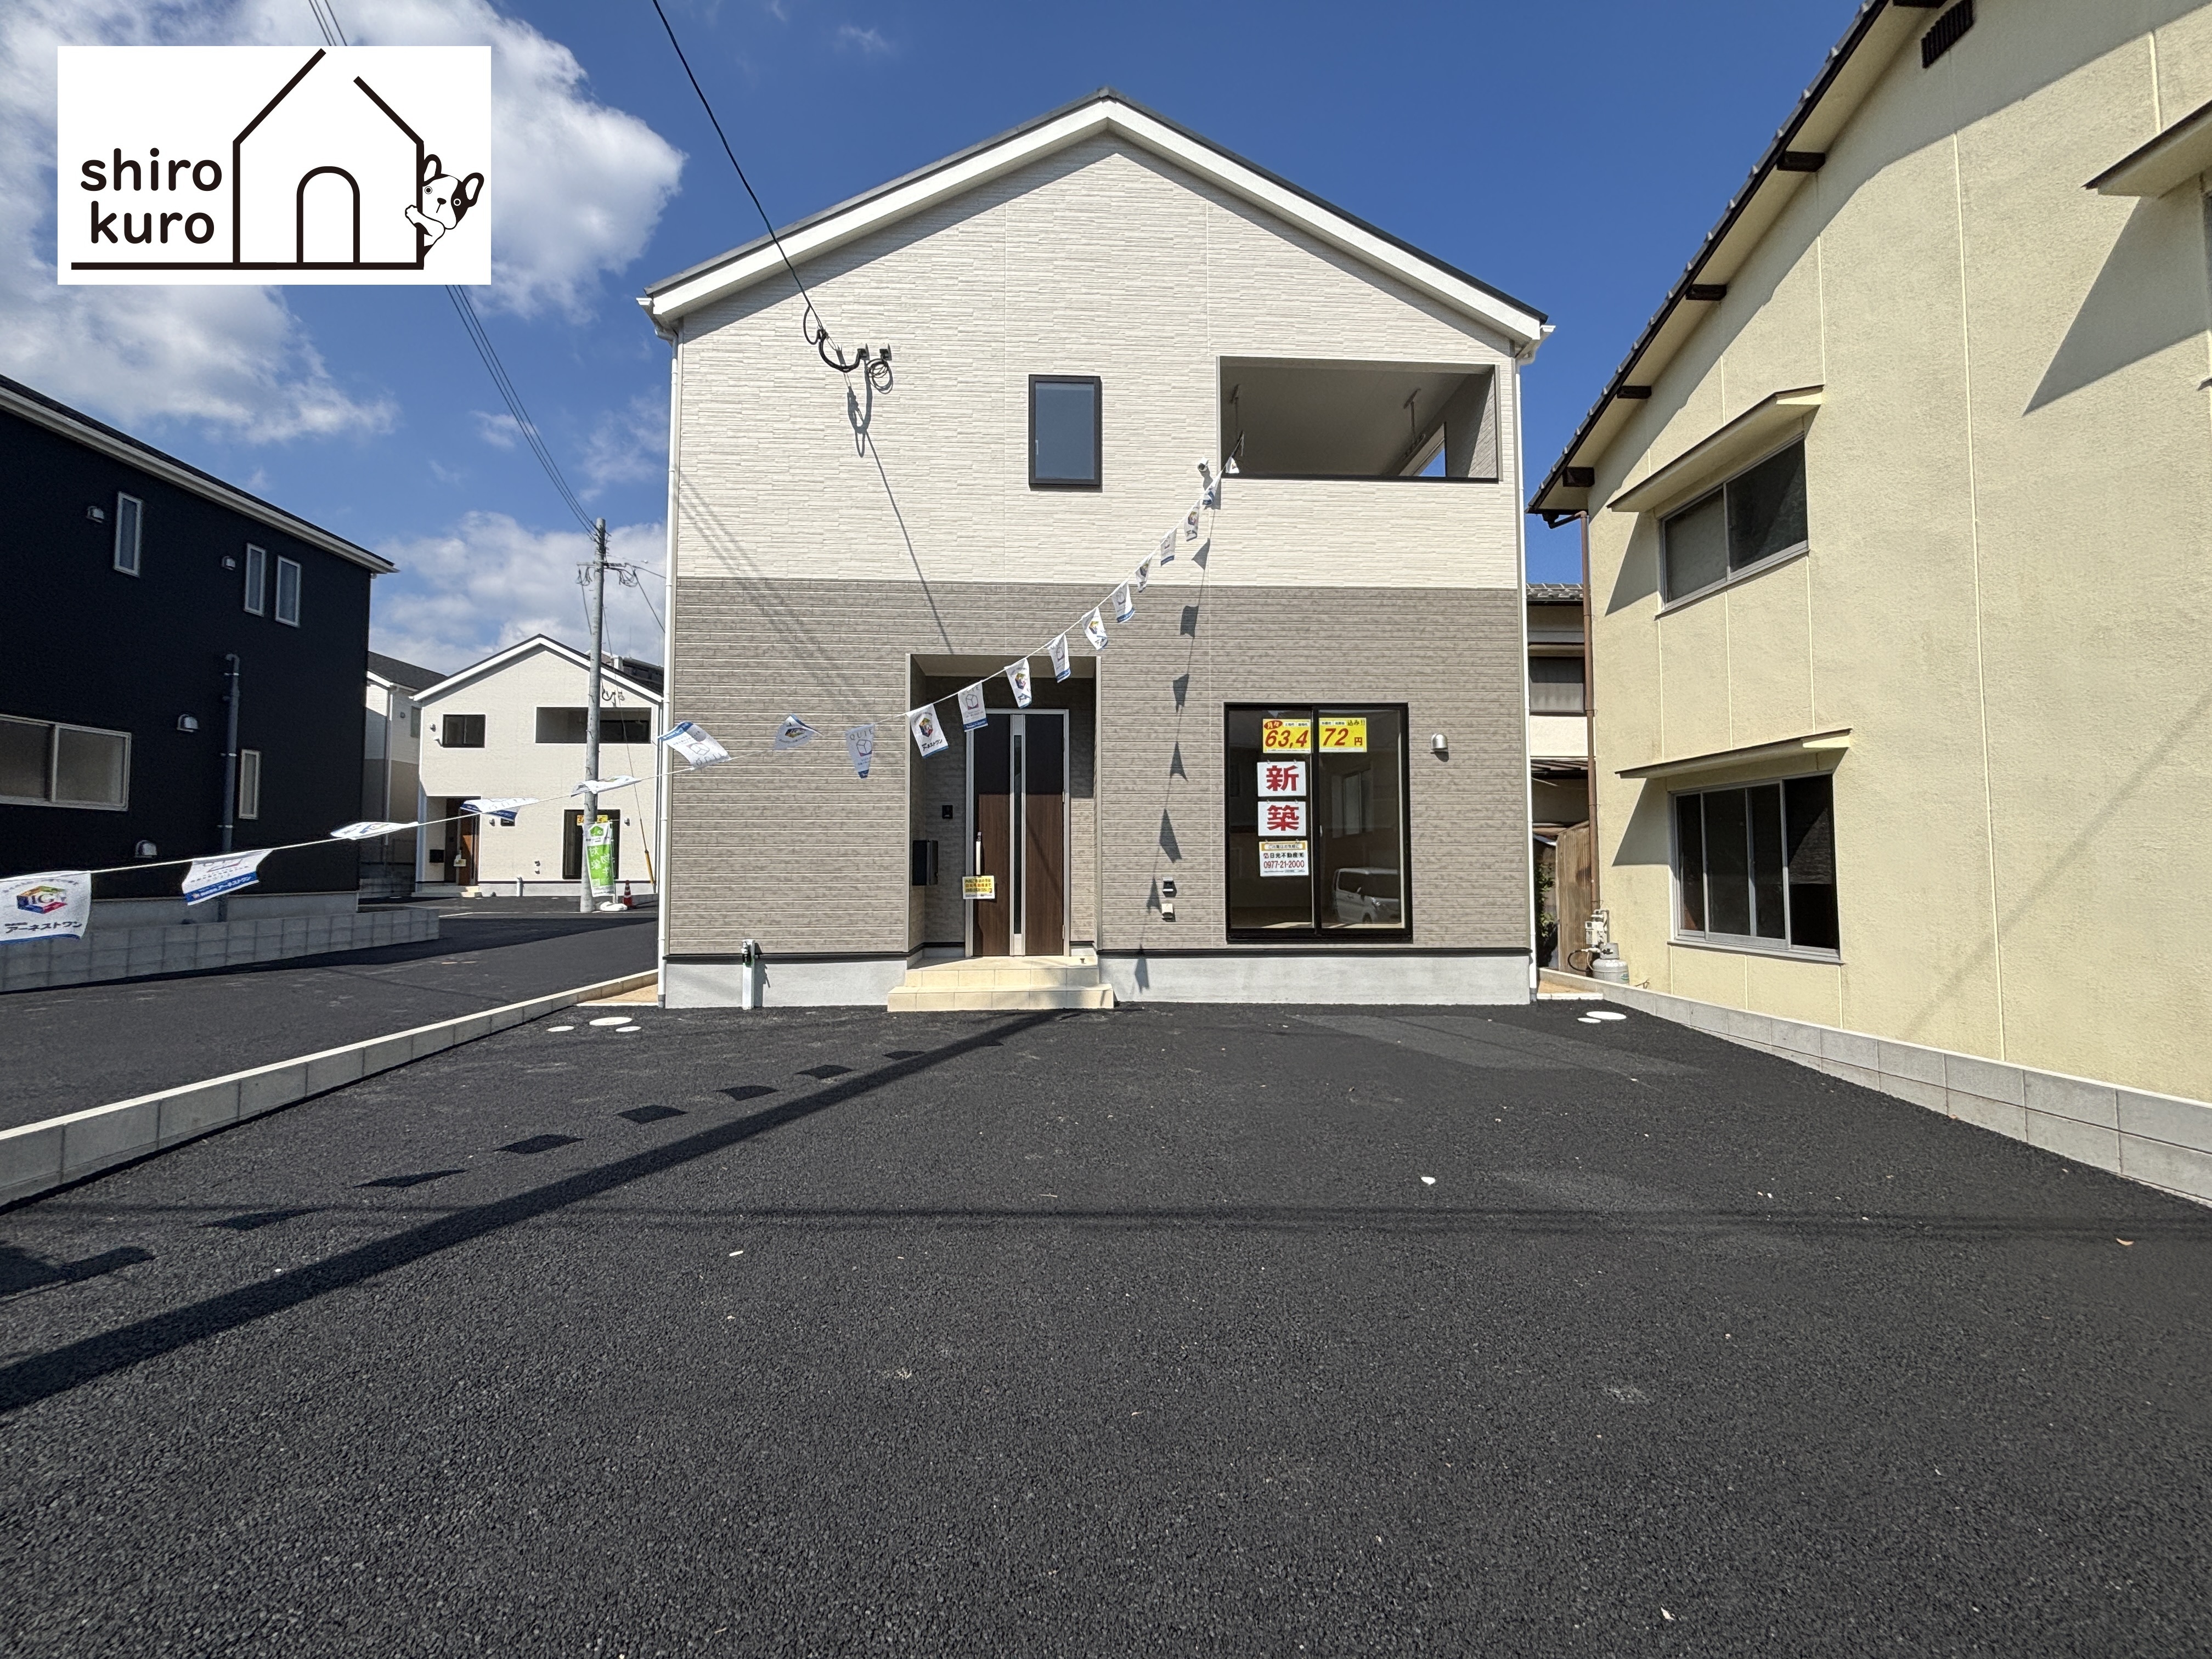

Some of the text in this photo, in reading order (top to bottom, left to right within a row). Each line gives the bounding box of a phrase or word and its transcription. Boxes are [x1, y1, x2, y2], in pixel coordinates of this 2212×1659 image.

[1265, 730, 1308, 748] 63,4
[1263, 860, 1305, 868] 0977-21-2000
[5, 921, 82, 934] アーネストワン
